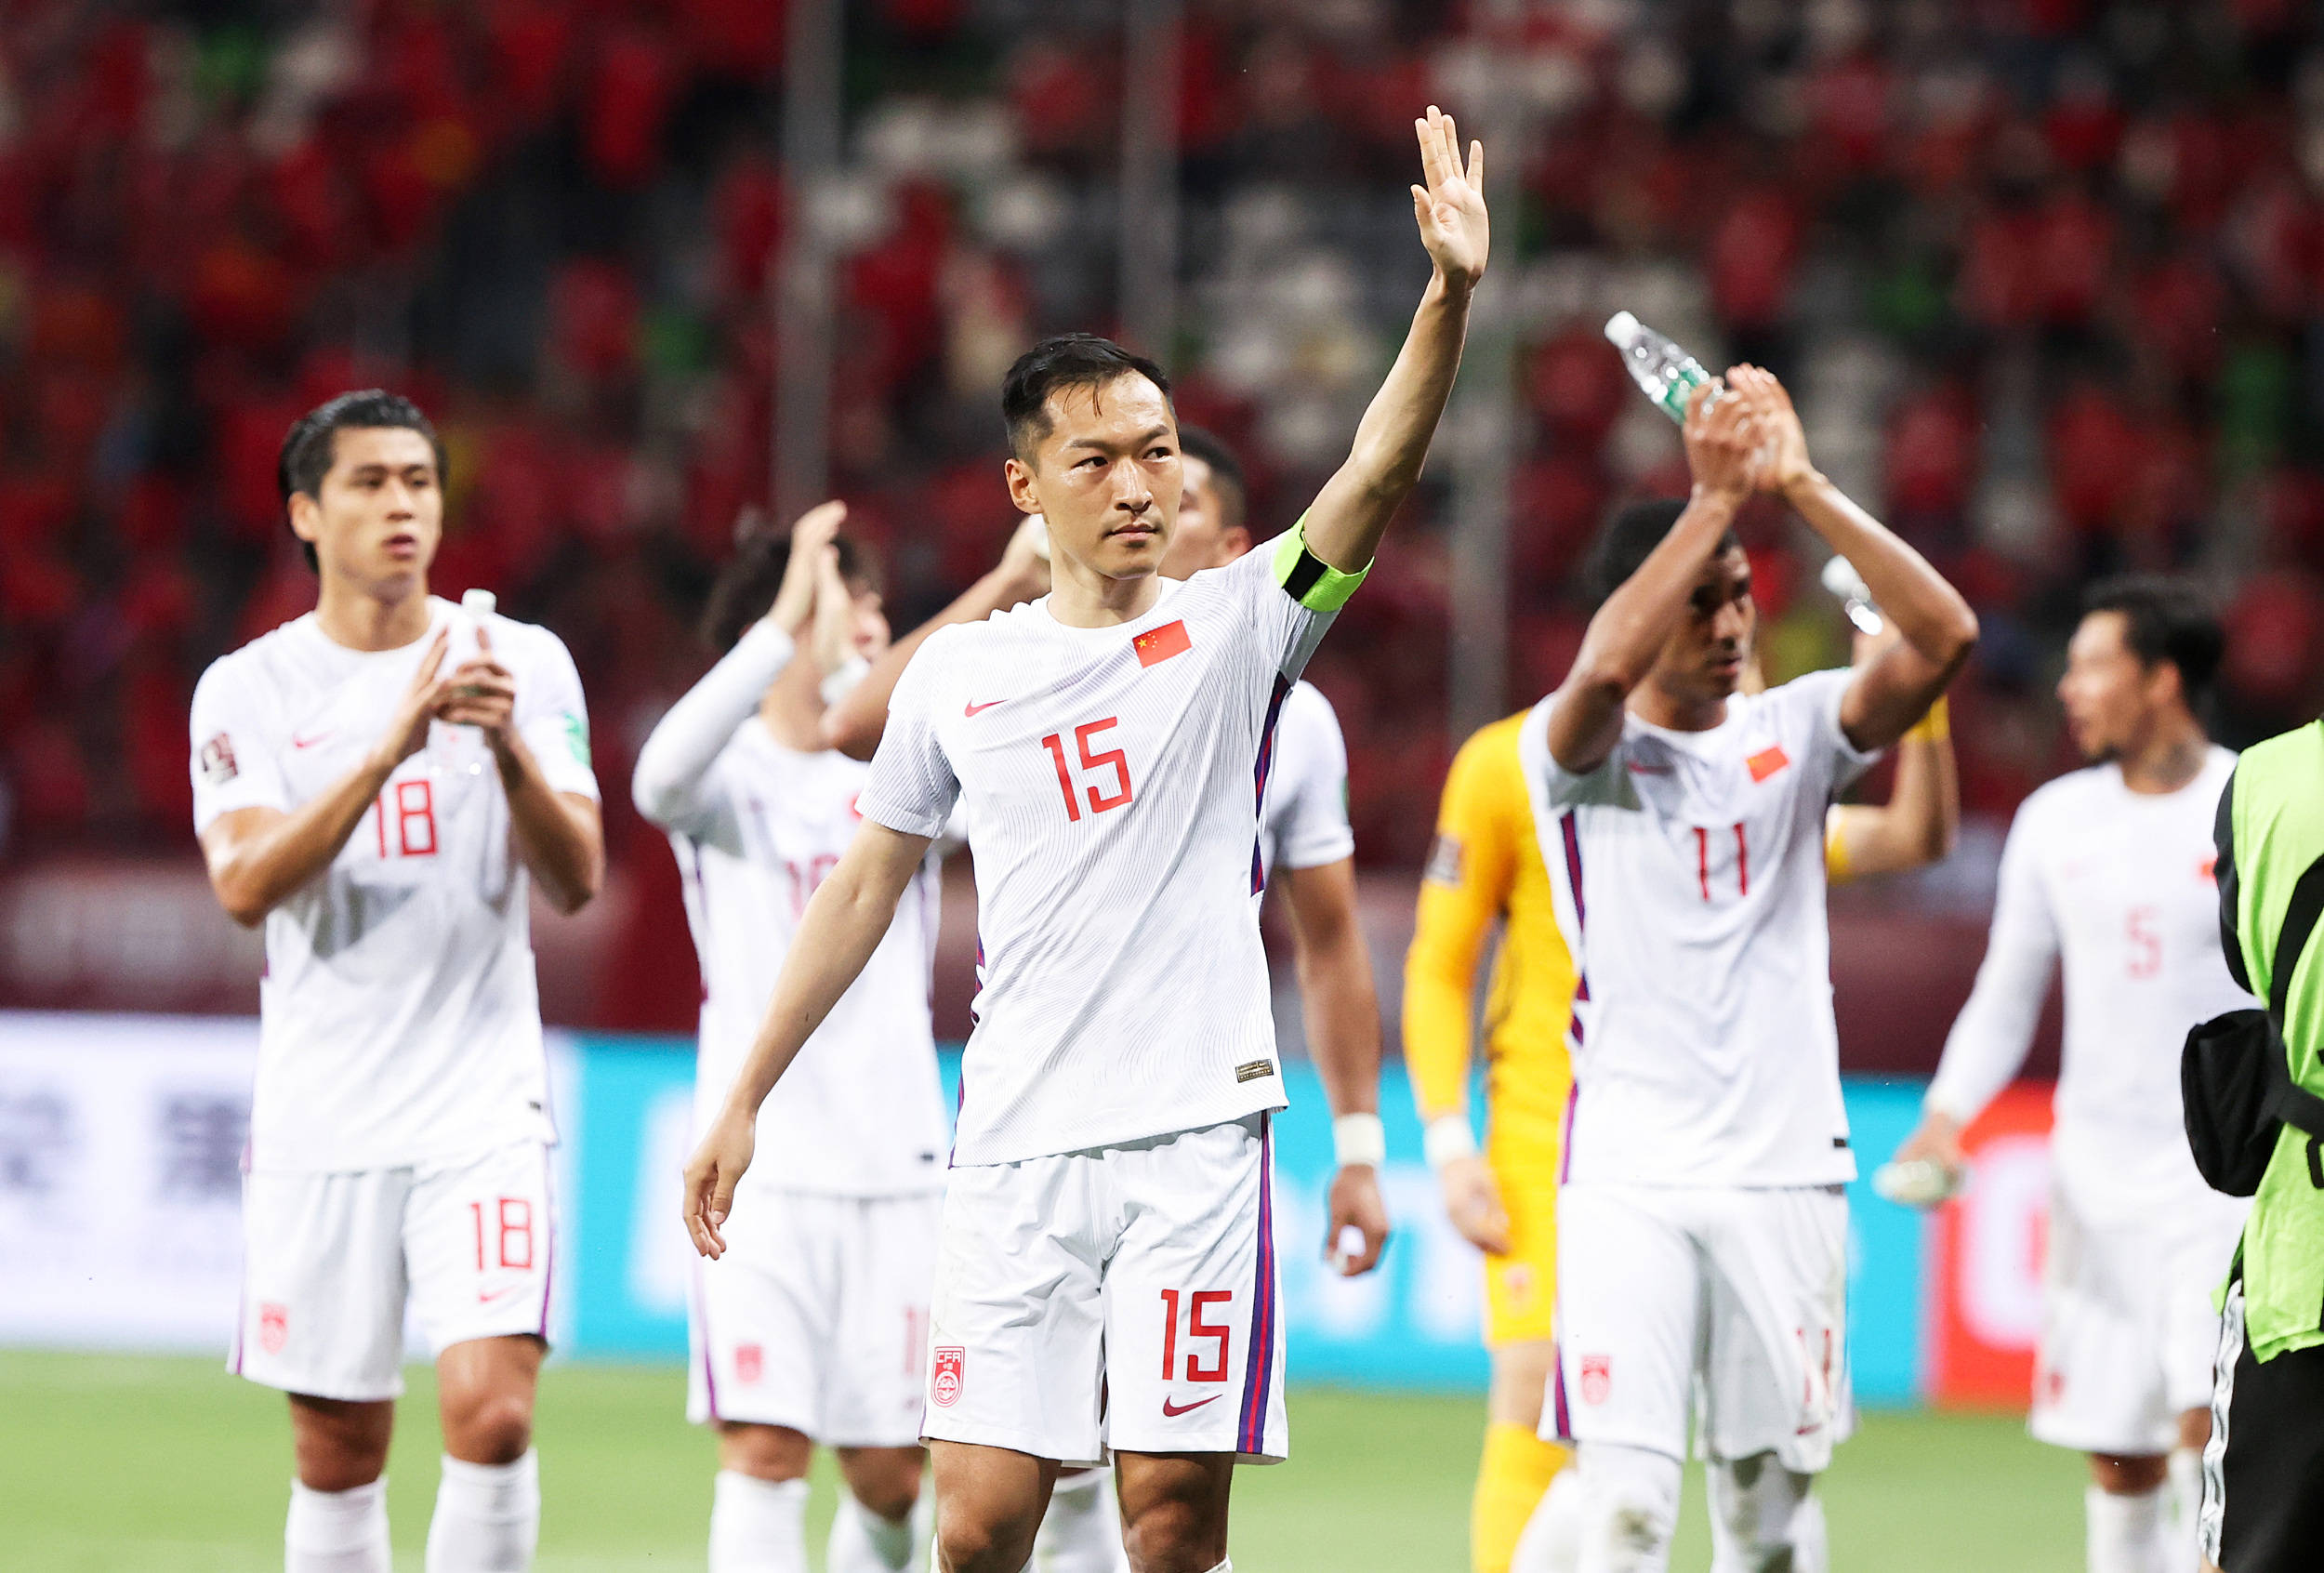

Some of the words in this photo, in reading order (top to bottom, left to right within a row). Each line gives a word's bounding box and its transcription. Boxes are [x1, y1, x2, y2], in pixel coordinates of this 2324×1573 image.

[1041, 716, 1134, 823] 15
[373, 779, 438, 859] 18
[1692, 822, 1750, 901] 11
[2127, 909, 2162, 981] 5
[471, 1197, 533, 1271] 18
[936, 1352, 961, 1364] CFA
[1160, 1289, 1233, 1382] 15
